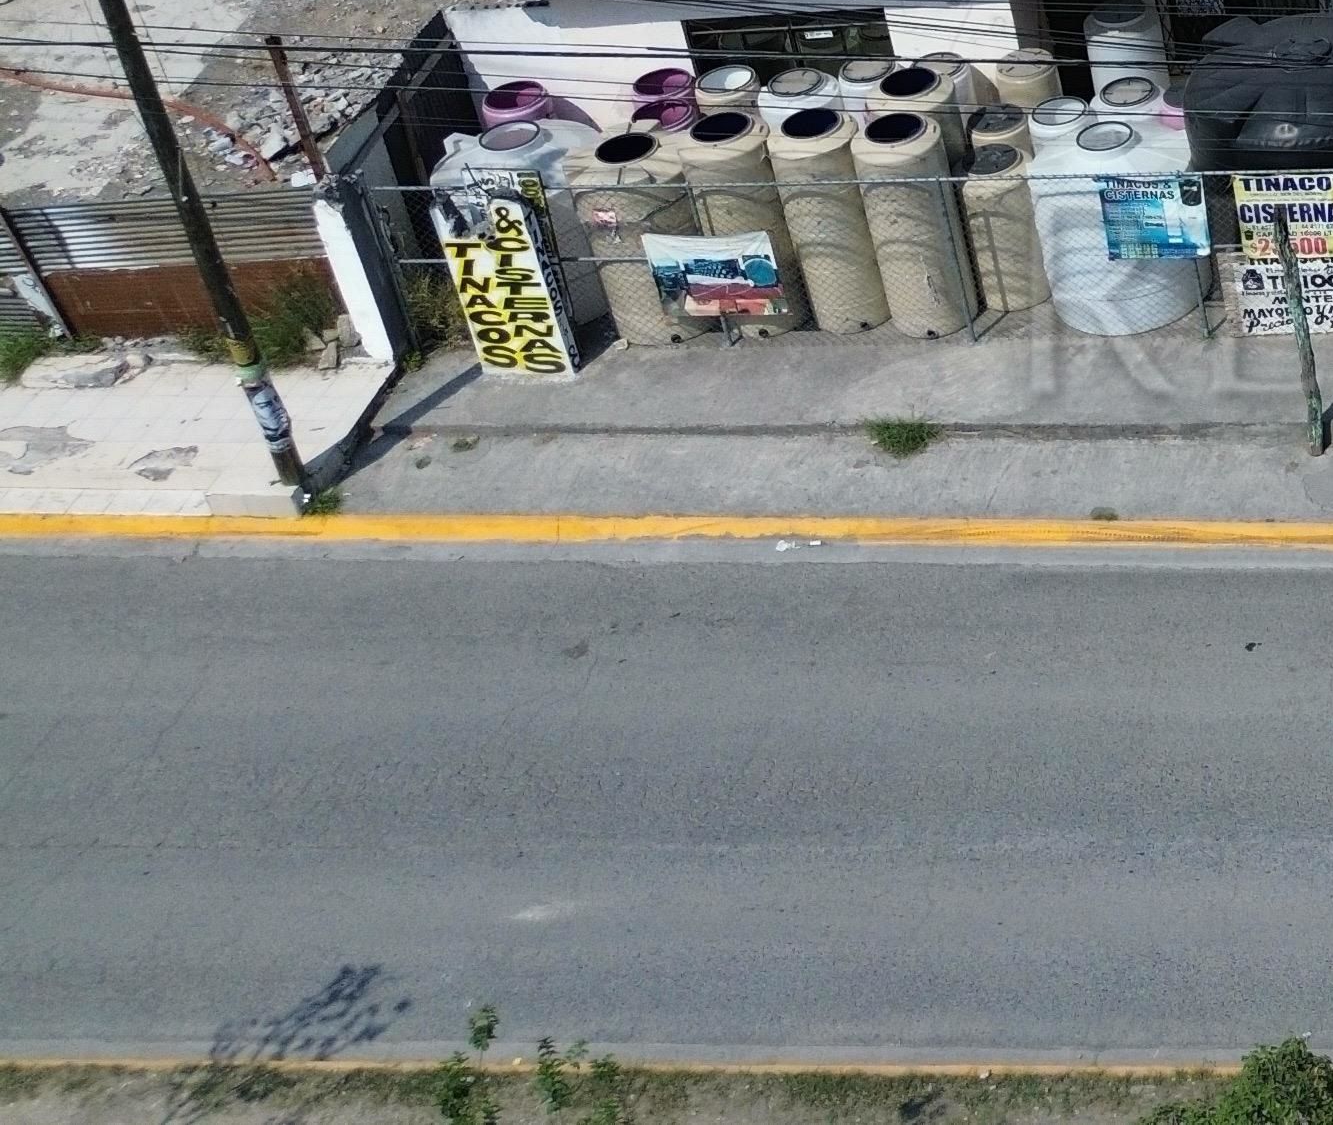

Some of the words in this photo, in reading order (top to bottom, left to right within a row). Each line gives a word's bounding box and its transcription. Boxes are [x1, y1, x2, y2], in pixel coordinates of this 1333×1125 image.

[1104, 179, 1160, 190] TINACOS
[1239, 177, 1332, 191] TINACO
[1104, 191, 1175, 201] CISTERNAS
[494, 206, 524, 237] &
[445, 242, 519, 369] TINACOS
[486, 237, 566, 374] CISTERNAS
[1243, 305, 1313, 319] MAYORO
